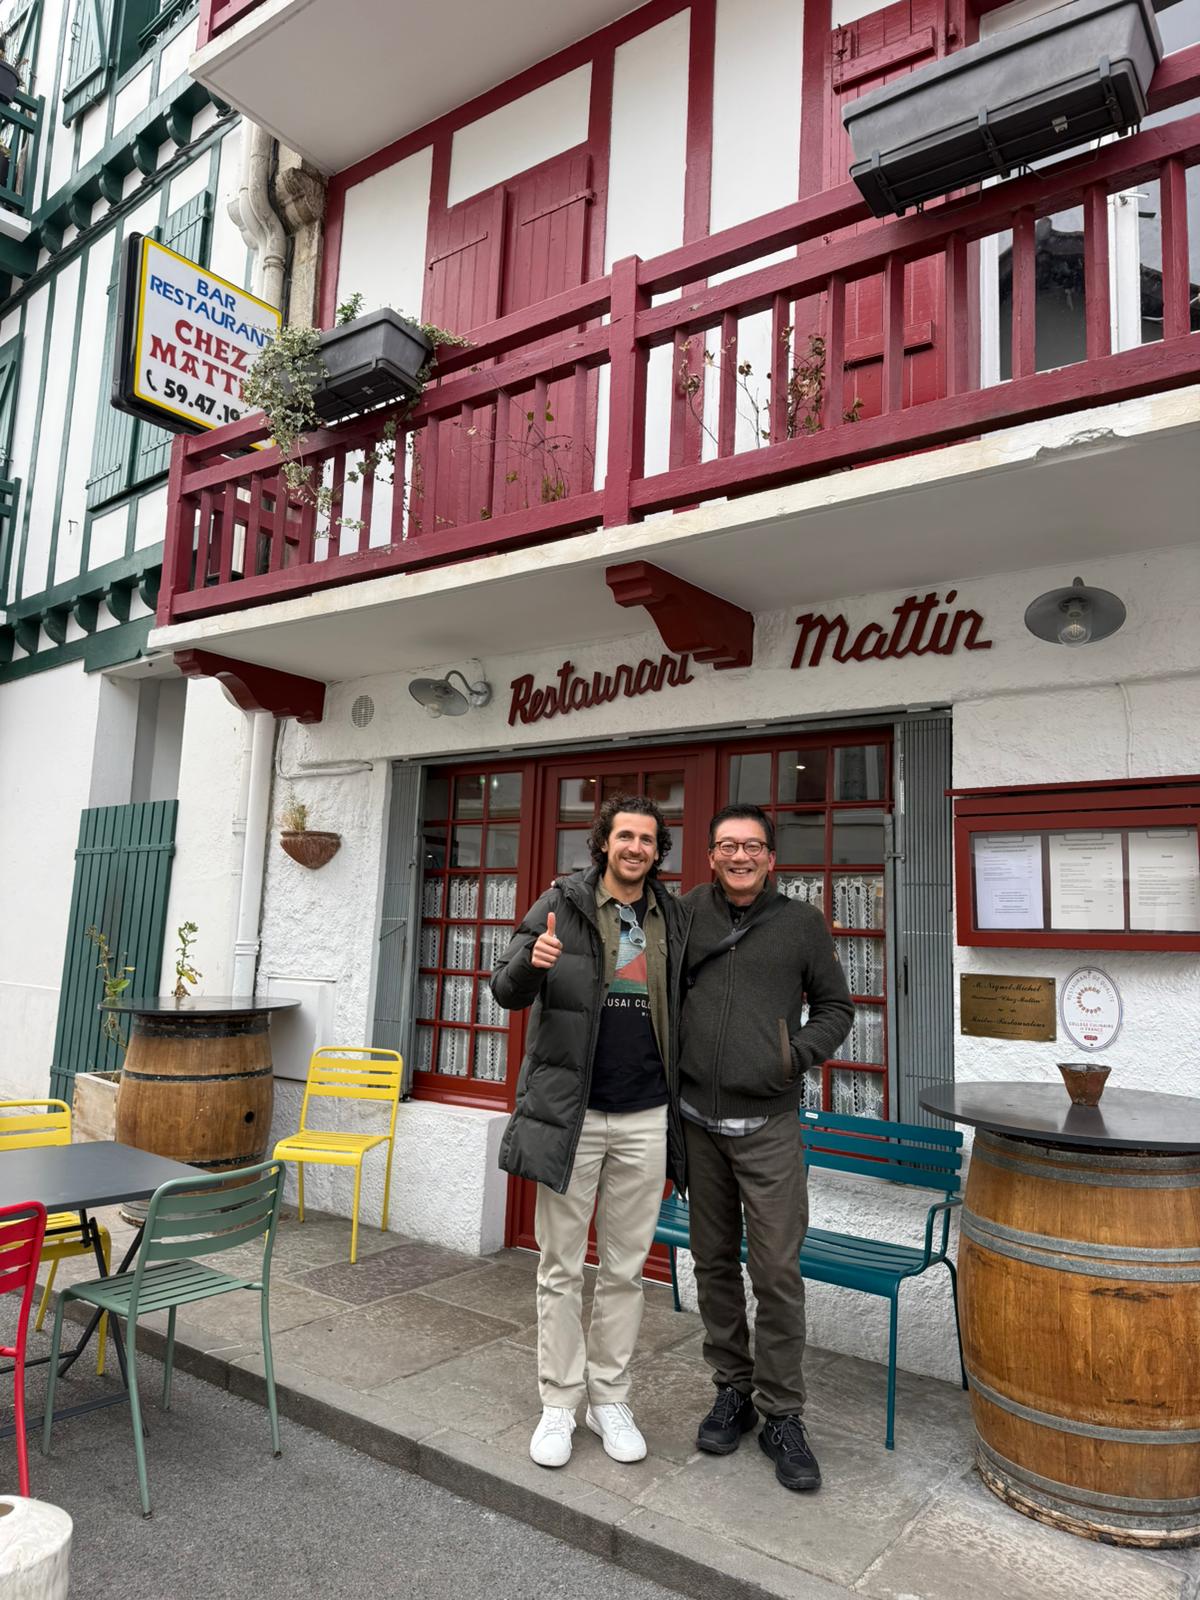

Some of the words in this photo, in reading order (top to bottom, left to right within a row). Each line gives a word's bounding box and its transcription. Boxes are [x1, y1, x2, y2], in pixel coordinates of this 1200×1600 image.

[150, 275, 275, 348] RESTAURANT
[197, 279, 236, 312] BAR
[175, 319, 249, 373] CHEZ
